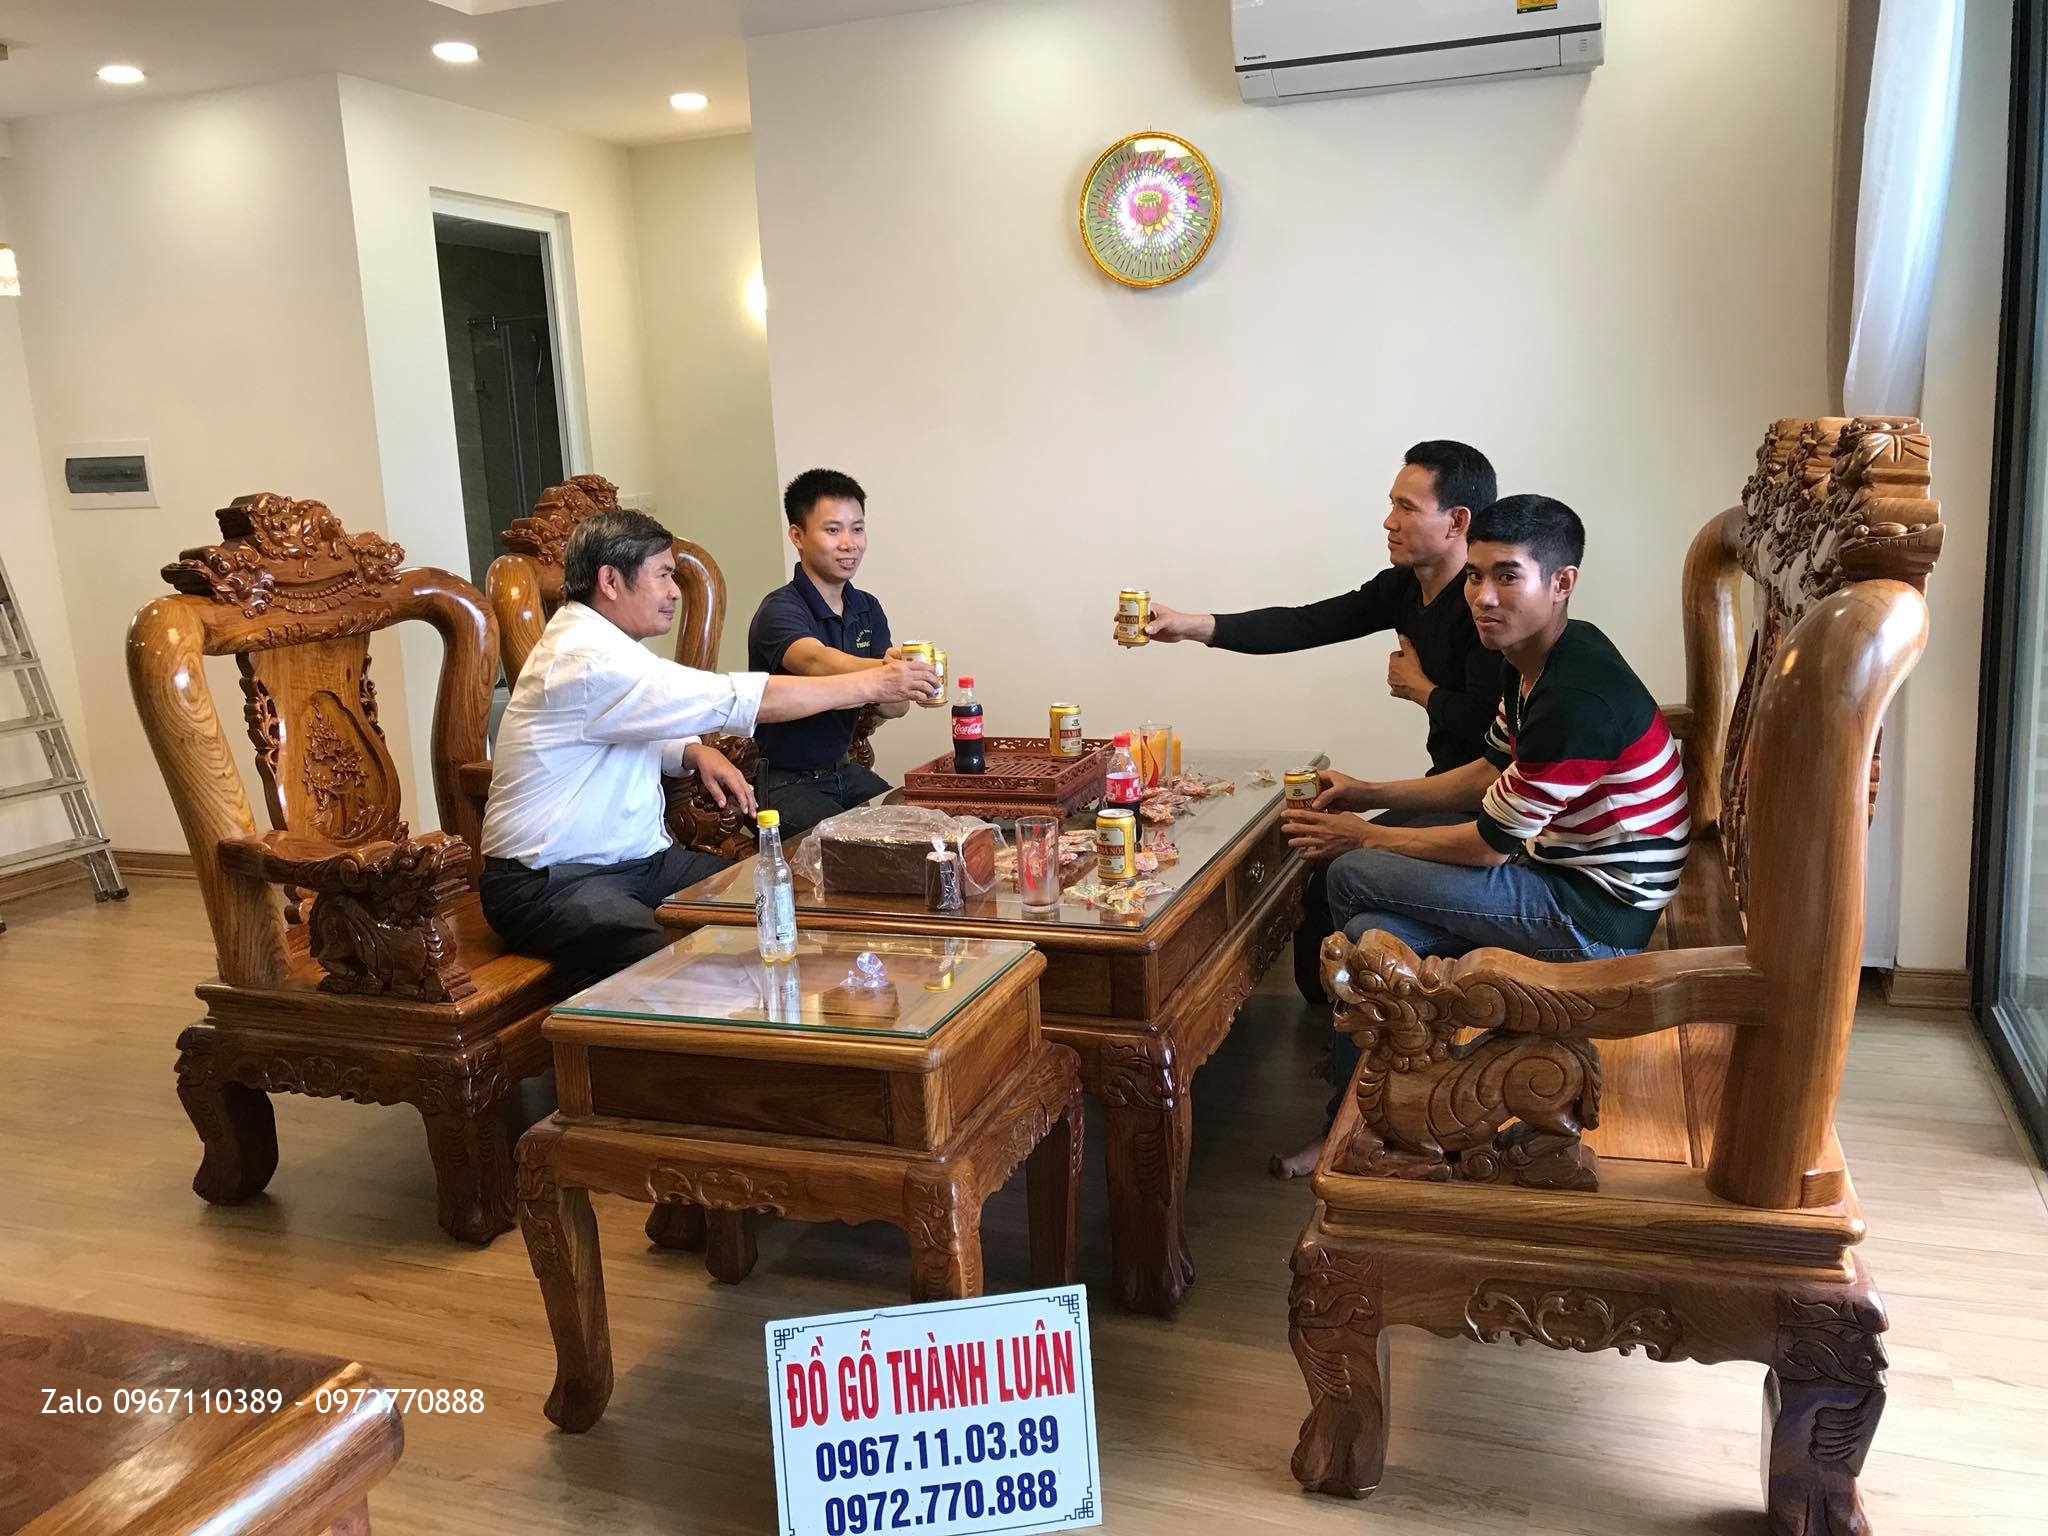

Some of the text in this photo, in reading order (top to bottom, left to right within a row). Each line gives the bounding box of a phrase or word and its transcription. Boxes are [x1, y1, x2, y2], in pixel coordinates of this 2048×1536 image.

[786, 1319, 1076, 1428] ĐỒ GỖ THÀNH LUÂN
[816, 1415, 1060, 1482] 0967.11.03.89
[825, 1469, 1058, 1536] 0972.770.888
